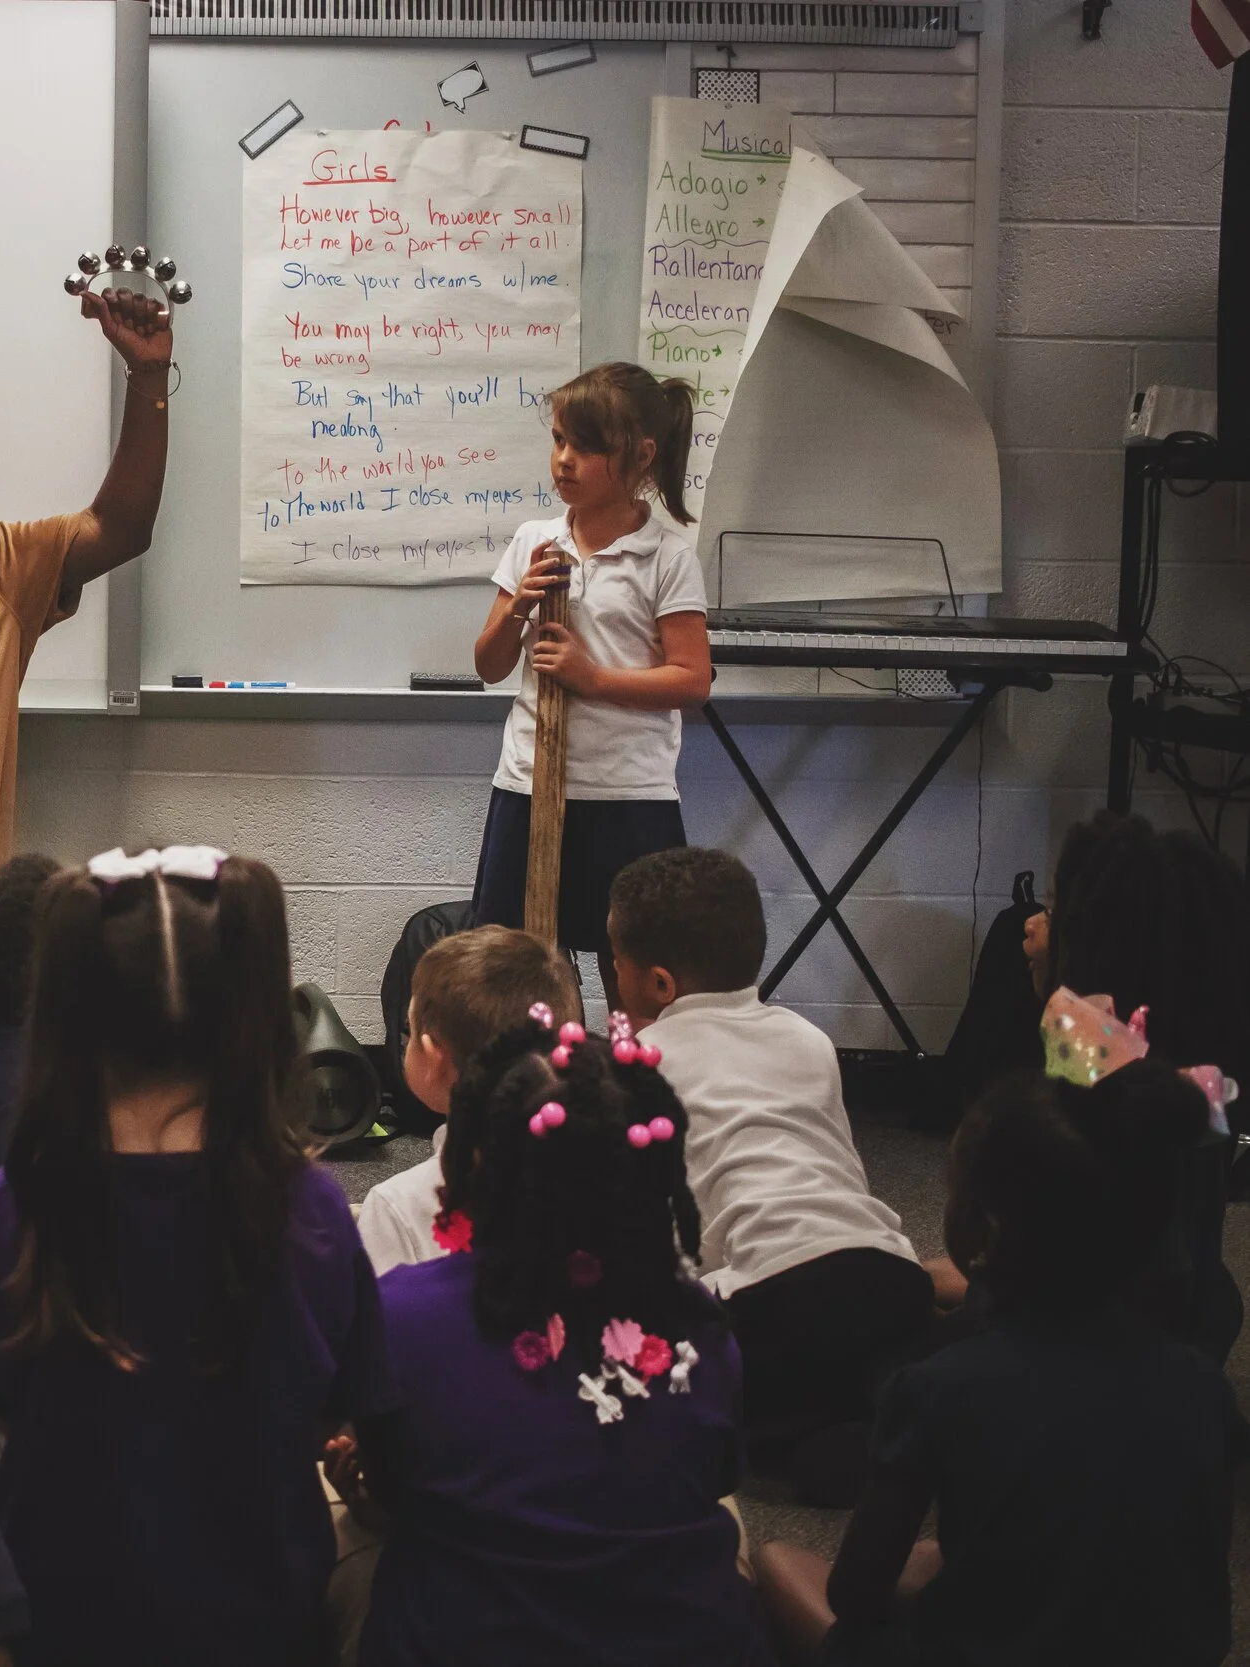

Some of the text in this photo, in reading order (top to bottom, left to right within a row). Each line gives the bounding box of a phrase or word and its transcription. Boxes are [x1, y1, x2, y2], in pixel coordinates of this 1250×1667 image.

[703, 119, 791, 155] Musical
[311, 150, 390, 181] Girls
[656, 161, 748, 210] Adagio
[280, 192, 570, 235] However big, however small
[655, 204, 738, 249] Allegro
[281, 224, 312, 251] Let
[321, 238, 342, 250] me
[351, 229, 374, 257] be
[384, 240, 396, 252] a
[408, 232, 449, 259] part
[459, 230, 490, 251] of
[501, 231, 522, 252] it
[281, 262, 346, 289] Share
[354, 273, 399, 301] your
[414, 268, 482, 290] dreams
[647, 289, 750, 323] Acceleran
[285, 311, 560, 356] You may be right, you may
[647, 331, 710, 363] Piano
[281, 346, 370, 375] be wrong
[291, 380, 327, 408] But
[345, 389, 372, 422] say
[382, 382, 425, 408] that
[446, 376, 498, 419] you'll
[277, 447, 497, 494] to the world you see
[257, 501, 279, 532] to
[380, 487, 401, 511] I
[409, 484, 453, 506] close
[533, 481, 552, 508] to
[291, 541, 316, 564] I
[333, 534, 382, 561] close
[402, 538, 430, 570] my
[436, 540, 477, 569] eyes
[479, 525, 495, 552] to
